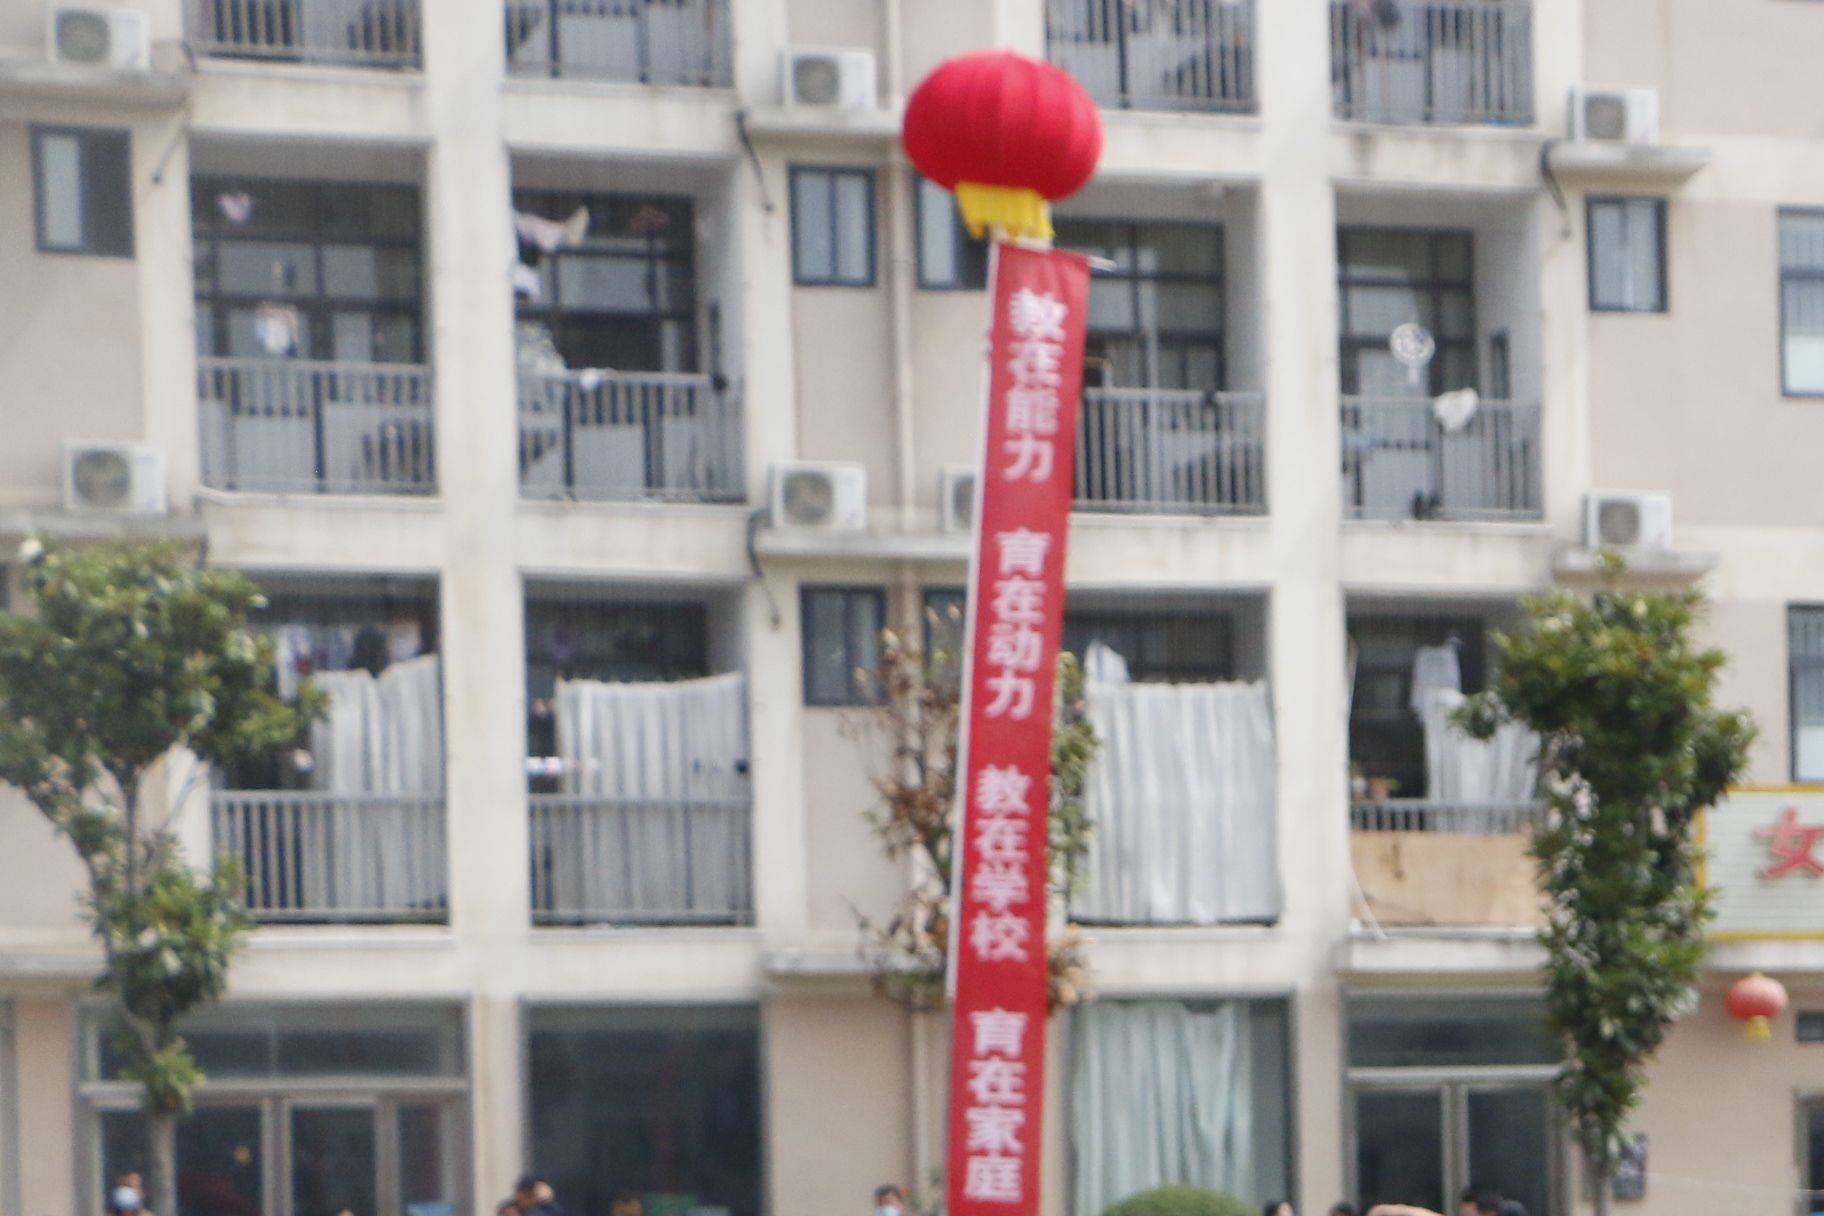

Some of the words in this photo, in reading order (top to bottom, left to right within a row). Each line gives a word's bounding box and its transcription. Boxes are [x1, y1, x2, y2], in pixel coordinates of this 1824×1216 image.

[1002, 286, 1068, 484] 教在能力
[969, 763, 1033, 962] 教在学校
[963, 1006, 1027, 1201] 育在家庭
